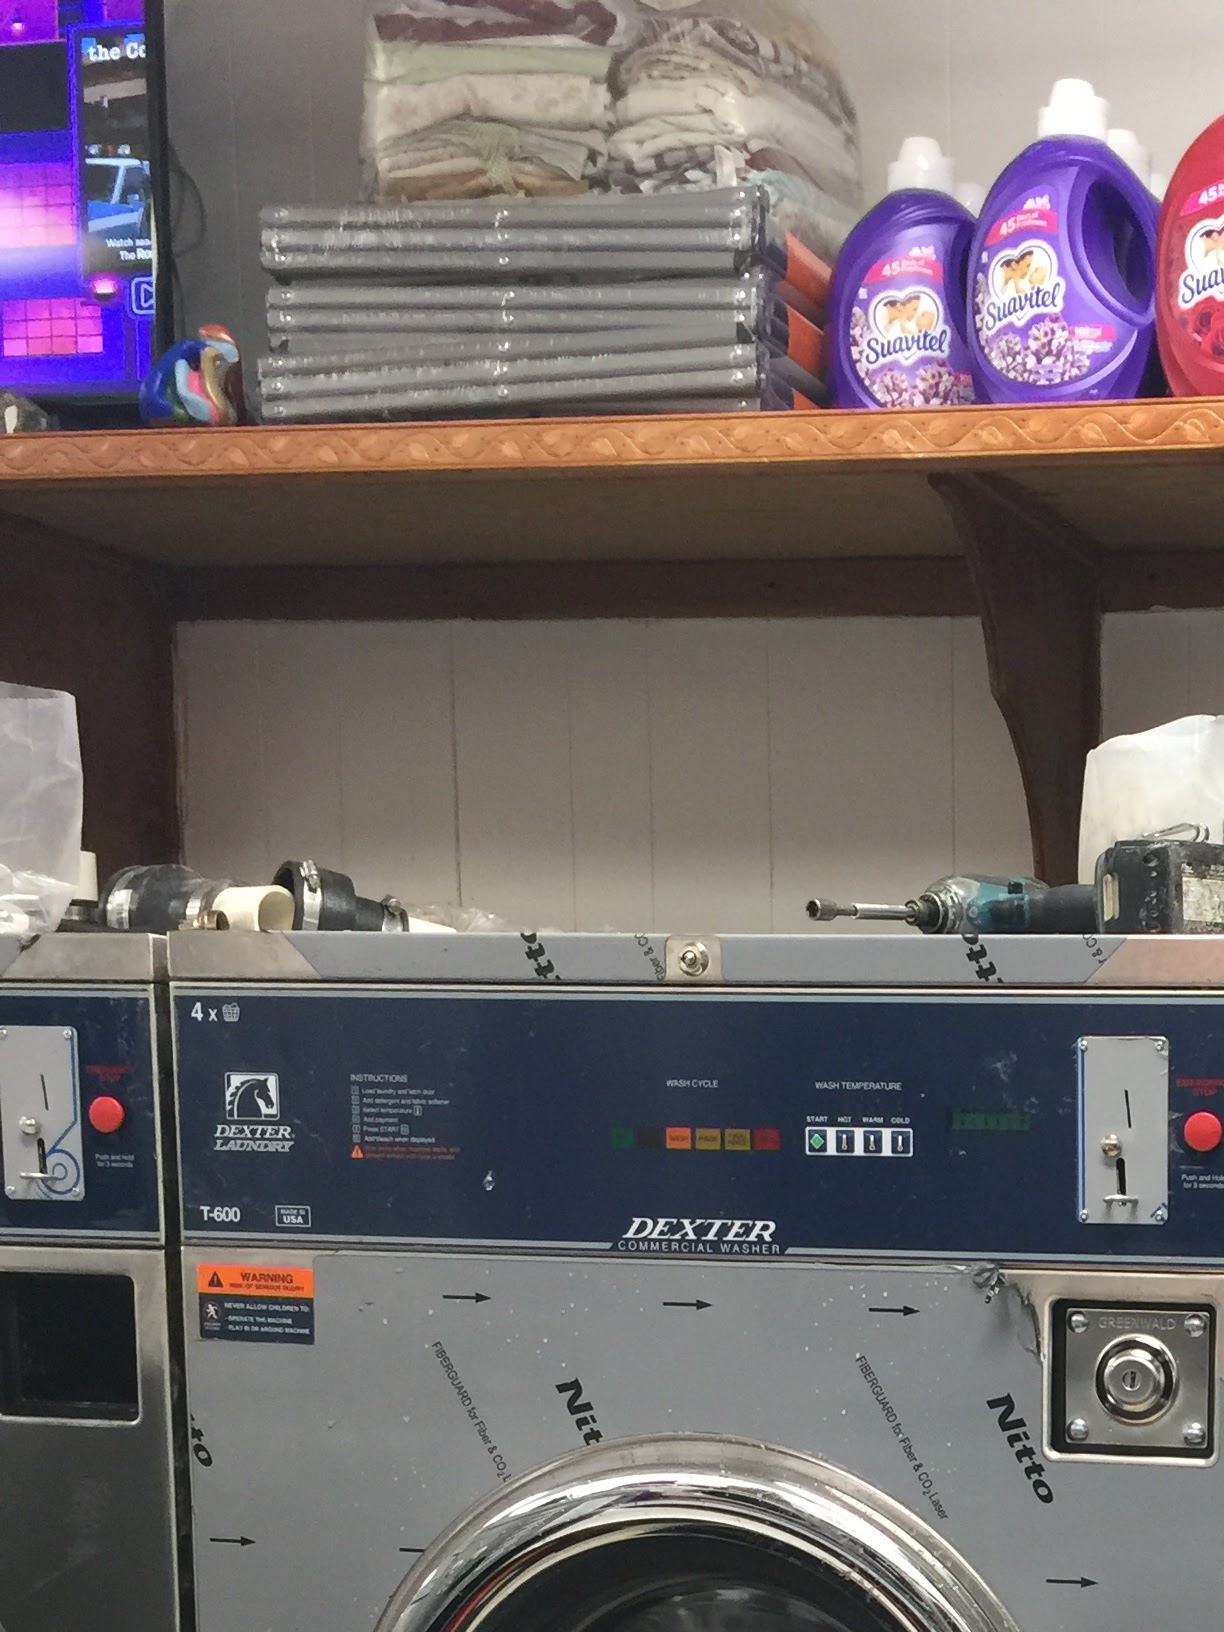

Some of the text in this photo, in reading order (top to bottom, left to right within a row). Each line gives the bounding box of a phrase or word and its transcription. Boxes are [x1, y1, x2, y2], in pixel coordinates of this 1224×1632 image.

[87, 44, 120, 62] the
[1198, 187, 1218, 206] 45
[999, 220, 1017, 236] 45
[105, 238, 134, 248] Watch
[119, 250, 136, 260] The
[985, 281, 1062, 330] Suavitel
[865, 329, 948, 365] Suavitel
[191, 1001, 204, 1022] 4
[350, 1073, 408, 1083] INSTRUCTIONS
[666, 1079, 719, 1089] WASH CYCLE
[814, 1081, 902, 1091] WASH TEMPERATURE
[806, 1115, 828, 1123] START
[862, 1116, 884, 1124] WARM
[890, 1117, 910, 1125] COLD
[214, 1124, 292, 1139] DEXTER
[213, 1139, 295, 1153] LAUNDRY
[1181, 1173, 1197, 1181] Push
[200, 1205, 241, 1223] T-600
[282, 1215, 304, 1224] USA
[622, 1217, 776, 1242] DEXTER
[618, 1240, 780, 1254] COMMERCIAL WASHER
[240, 1271, 294, 1284] WARNING
[245, 1303, 267, 1311] ALLOW
[1098, 1316, 1177, 1331] GREENWALD
[431, 1340, 472, 1407] FIBERGUARD
[467, 1406, 479, 1421] for
[473, 1420, 493, 1445] Fiber
[487, 1445, 498, 1455] &
[555, 1377, 604, 1446] Nit
[855, 1355, 898, 1424] FIBERGUARD
[899, 1436, 918, 1463] Fiber
[912, 1462, 924, 1473] &
[928, 1491, 949, 1521] Laser
[986, 1392, 1054, 1504] Nitto
